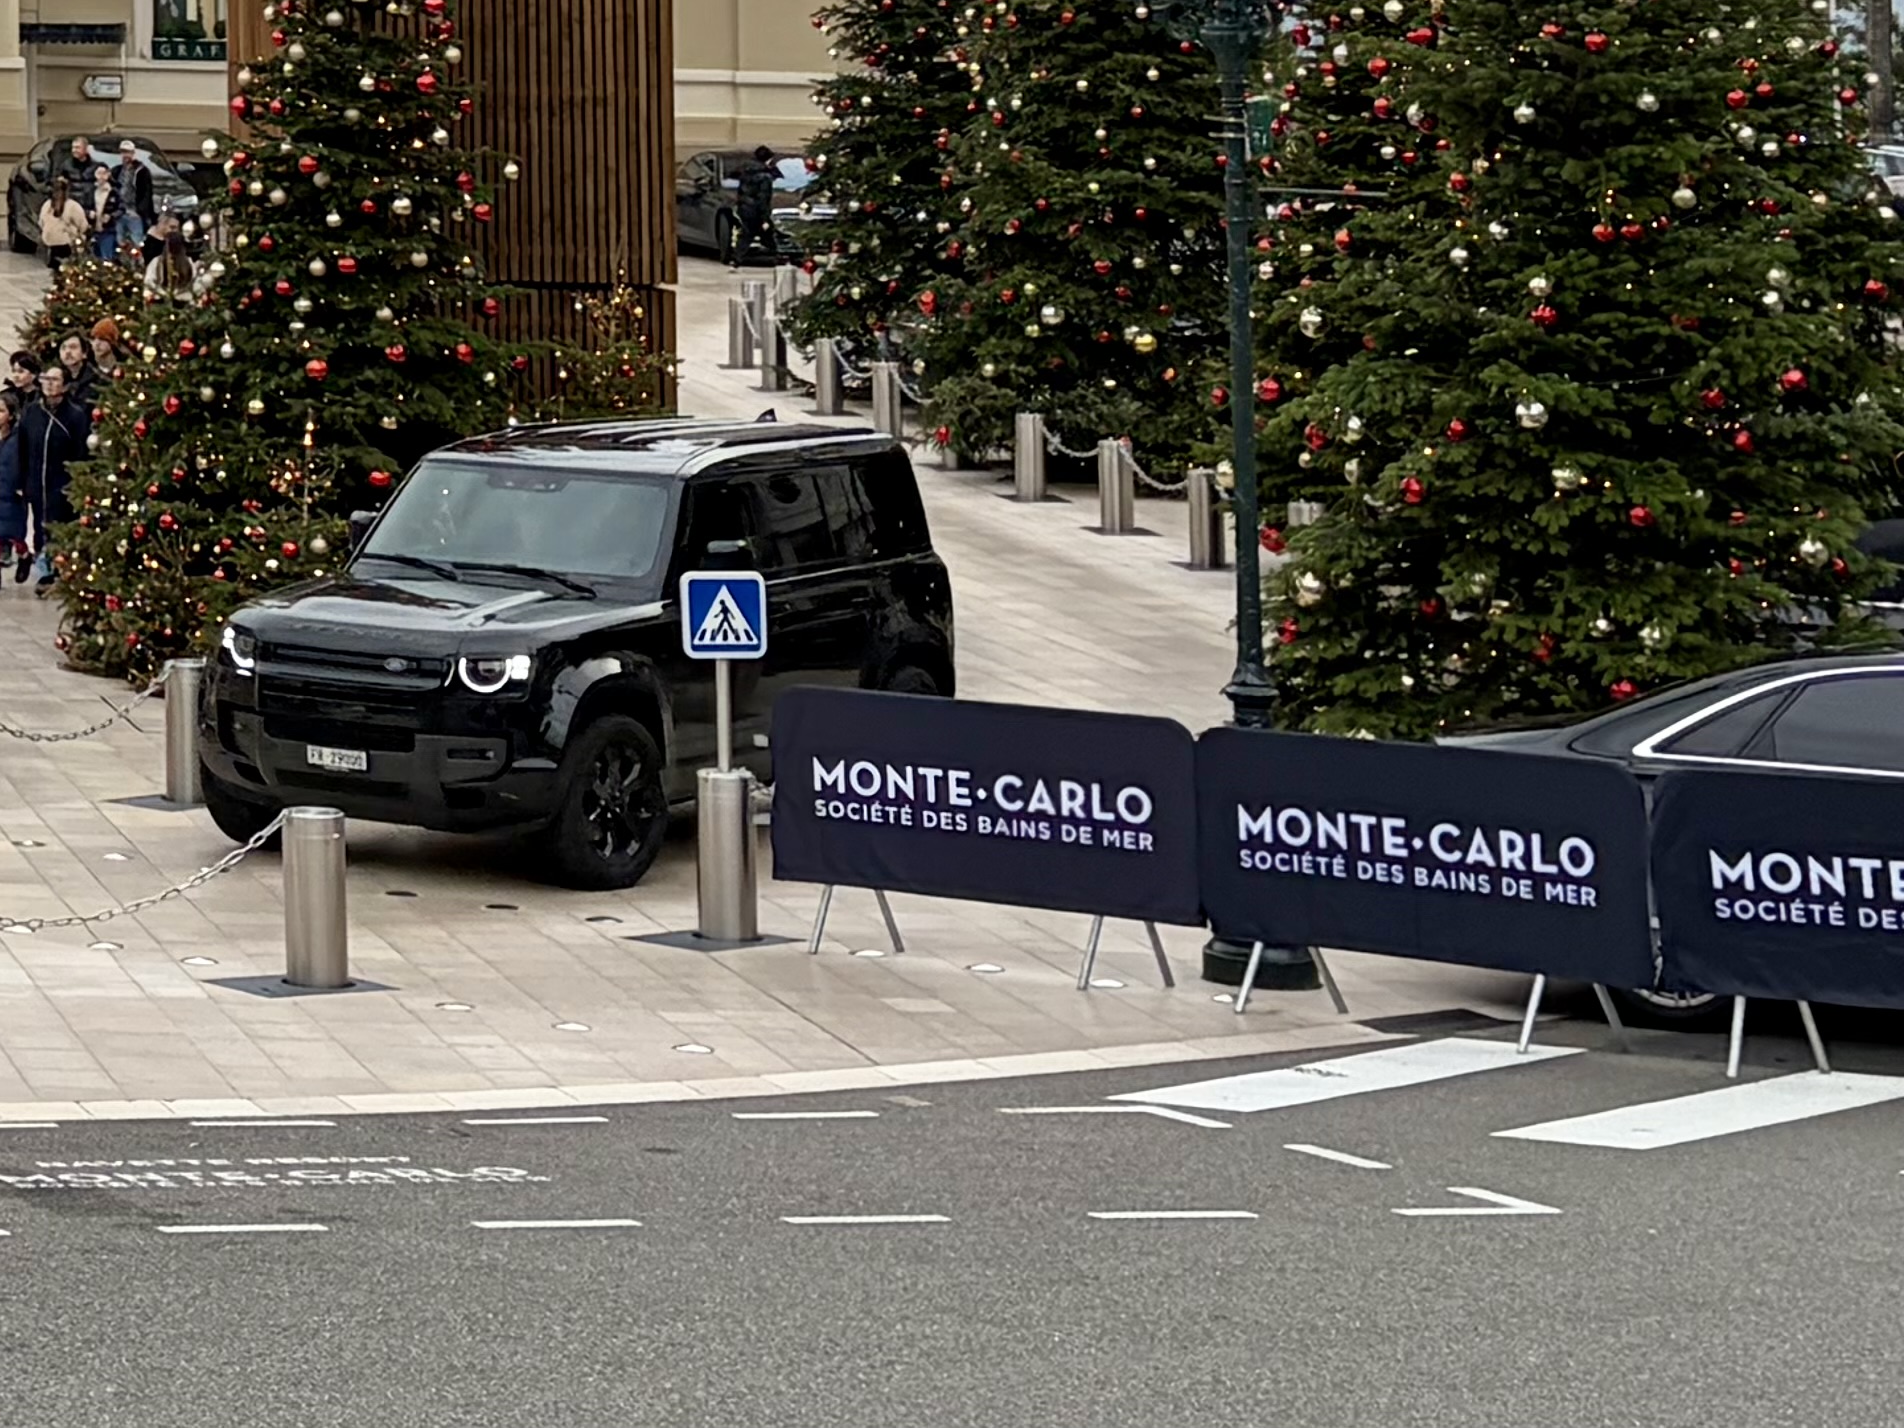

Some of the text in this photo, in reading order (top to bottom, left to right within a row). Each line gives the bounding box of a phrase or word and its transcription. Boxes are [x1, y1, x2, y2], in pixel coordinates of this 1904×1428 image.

[814, 798, 1154, 853] SOCIÉTÉ DES BAINS DE MER
[1239, 848, 1597, 907] SOCIÉTÉ DES BAINS DE MER
[1714, 897, 1904, 930] SOCIÉTÉ DE
